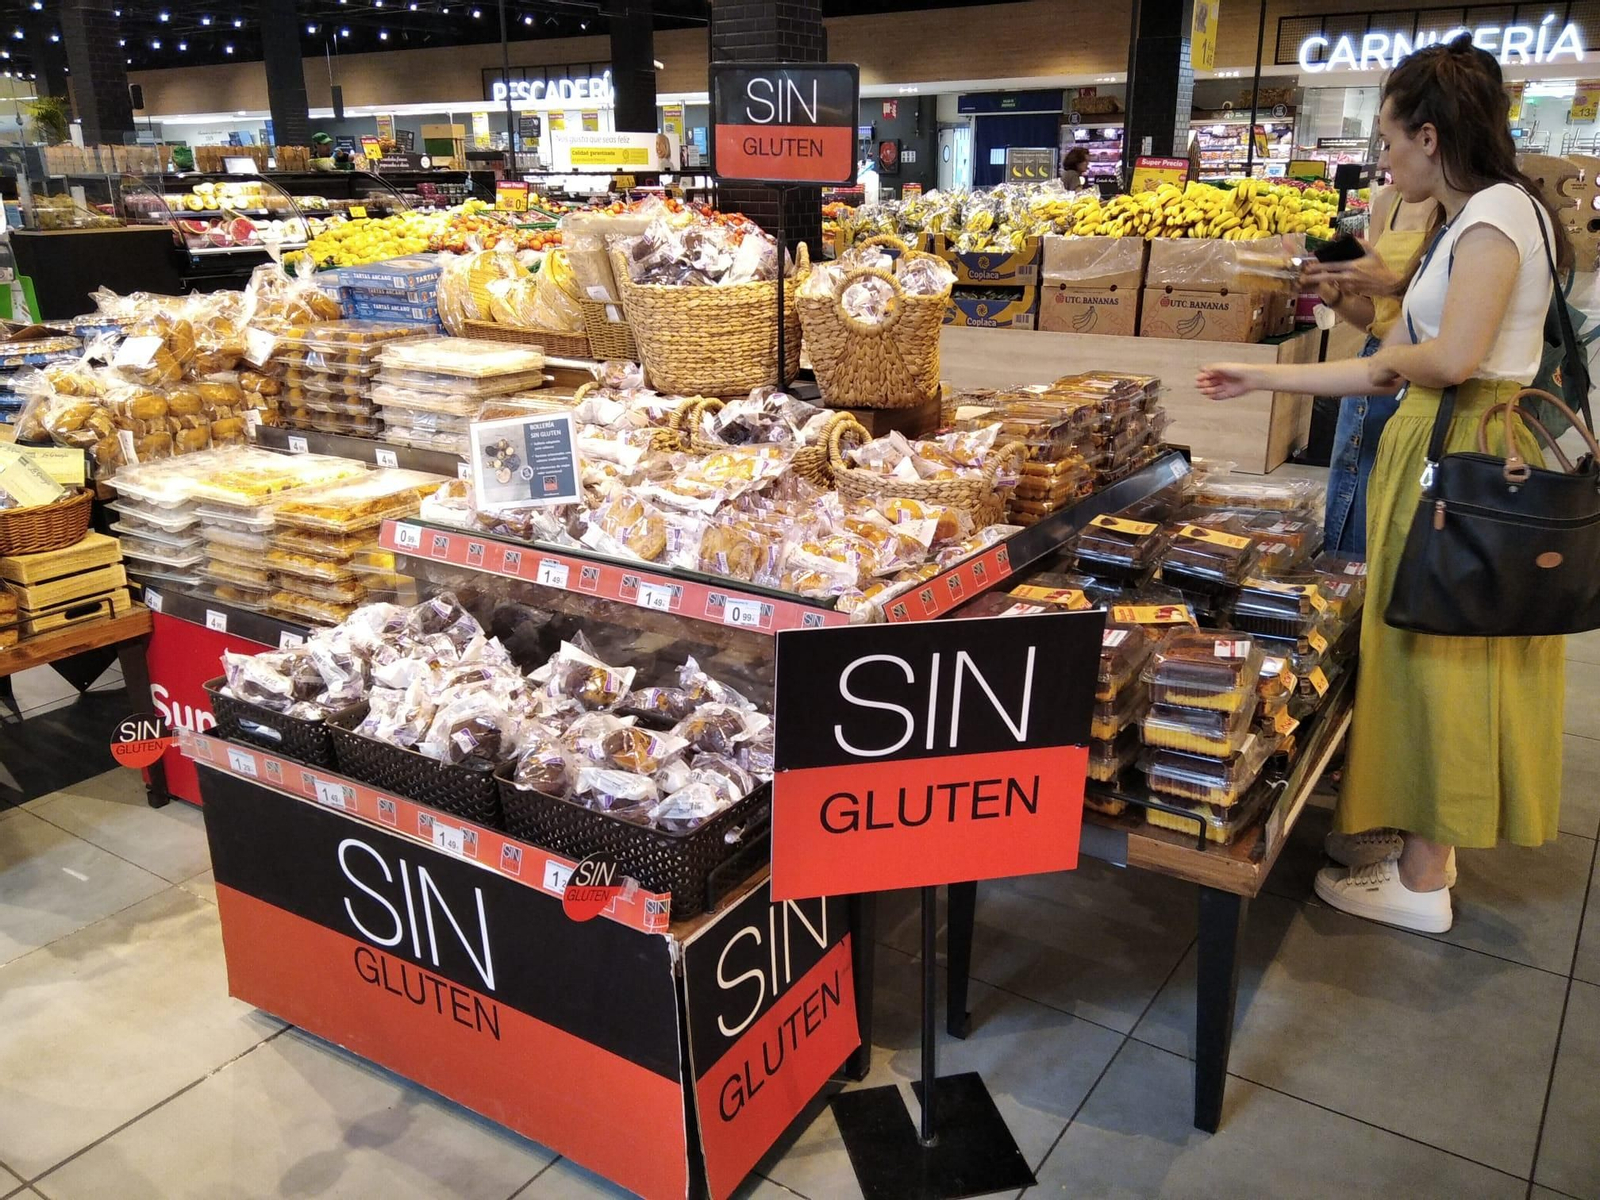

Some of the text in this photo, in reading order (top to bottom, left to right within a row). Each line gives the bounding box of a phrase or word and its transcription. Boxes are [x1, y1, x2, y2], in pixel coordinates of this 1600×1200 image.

[746, 78, 817, 124] SIN
[743, 137, 823, 157] GLUTEN
[1141, 158, 1183, 167] Super Precio
[415, 273, 438, 283] TARTAS
[968, 270, 999, 280] Coplaca
[1065, 296, 1119, 305] UTC BANANAS
[1170, 300, 1230, 310] UTC BANANAS
[966, 317, 997, 328] Coplaca
[540, 429, 562, 438] GLUTEN
[382, 455, 387, 465] 4
[400, 530, 407, 543] 0
[544, 570, 550, 583] 1
[645, 592, 652, 606] 1
[732, 607, 741, 621] 0
[211, 618, 217, 627] 4
[834, 646, 1036, 757] SIN
[119, 719, 160, 743] SIN
[116, 741, 164, 756] GLUTEN
[235, 757, 242, 771] 1
[322, 788, 329, 801] 1
[820, 775, 1040, 834] GLUTEN
[439, 831, 446, 847] 1
[503, 845, 521, 862] SIN
[552, 871, 559, 887] 1
[575, 861, 617, 886] SIN
[567, 889, 610, 902] GLUTEN
[646, 899, 668, 914] SIN
[338, 838, 496, 991] SIN
[717, 896, 828, 1037] SIN
[354, 946, 500, 1041] GLUTEN
[719, 970, 841, 1122] GLUTEN
